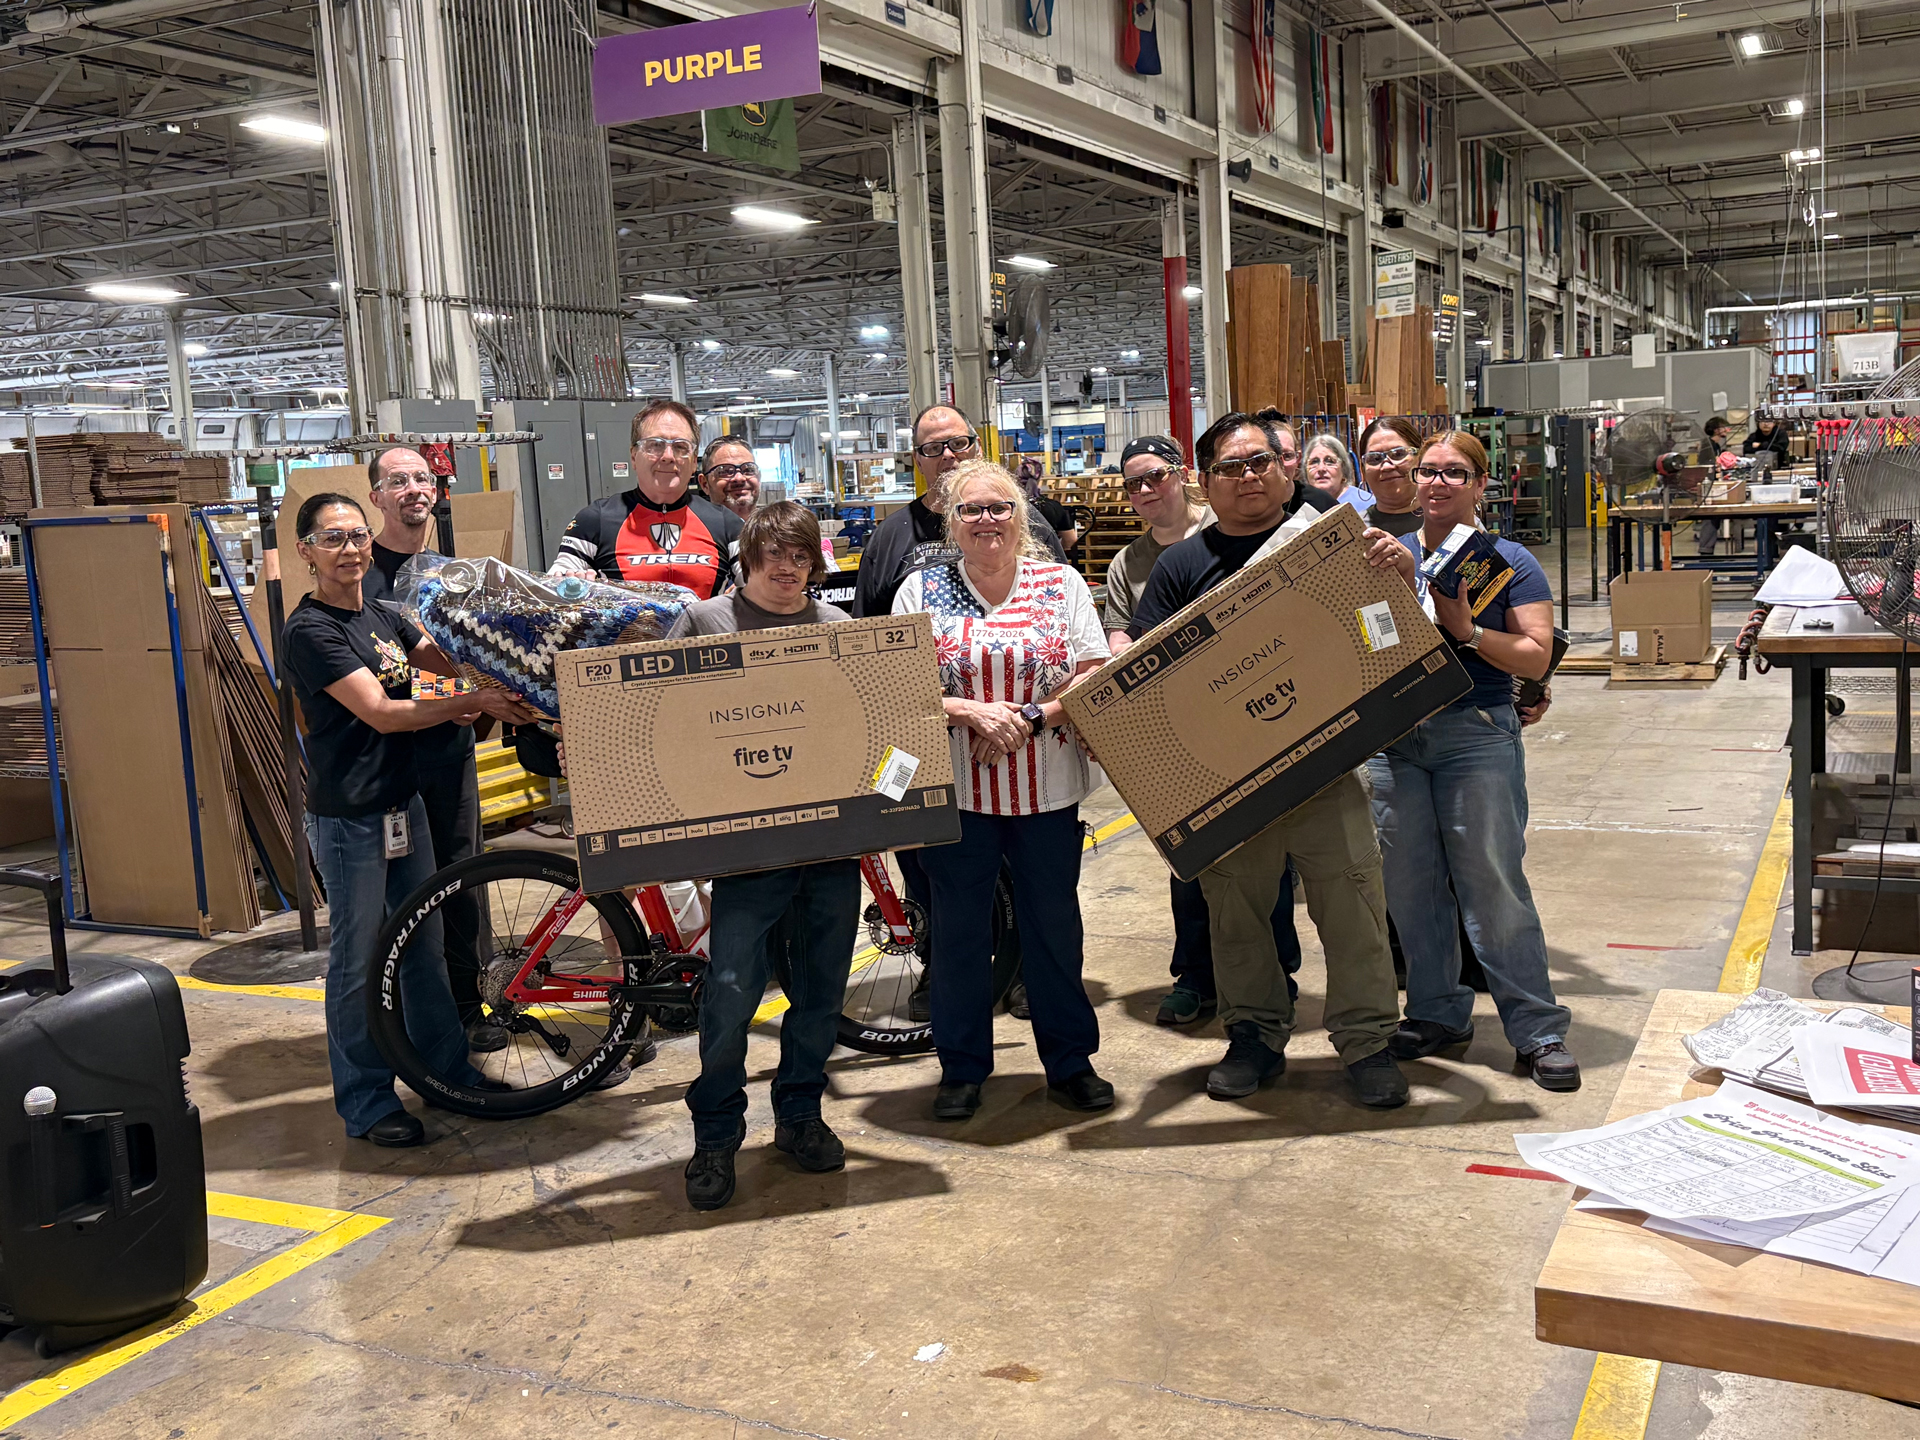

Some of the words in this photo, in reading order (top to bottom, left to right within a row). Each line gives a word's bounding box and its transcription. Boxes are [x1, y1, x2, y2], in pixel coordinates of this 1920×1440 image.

[644, 44, 762, 87] PURPLE
[727, 126, 753, 142] JOHN
[753, 132, 777, 149] DEERE
[1378, 254, 1397, 266] SAFETY
[1397, 251, 1413, 263] FIRST
[1853, 360, 1879, 372] 713B
[627, 553, 713, 565] TREK
[820, 586, 856, 603] ATRICK
[970, 629, 1025, 639] 1776-2026
[1173, 625, 1200, 648] HD
[699, 648, 729, 666] HD
[1656, 635, 1664, 663] KALAS
[585, 664, 612, 678] F20
[629, 655, 675, 677] LED
[1121, 653, 1161, 687] LED
[1208, 635, 1286, 693] INSIGNIA
[631, 680, 647, 688] Crystal
[658, 677, 674, 685] images
[1133, 686, 1145, 696] Crystal
[1153, 672, 1167, 683] images
[1178, 657, 1186, 666] best
[1090, 685, 1113, 706] F20
[1097, 695, 1115, 708] SERIES
[1245, 692, 1278, 718] fire
[1275, 678, 1296, 697] tv
[709, 700, 804, 724] INSIGNIA
[733, 747, 769, 767] fire
[772, 745, 793, 761] tv
[871, 855, 892, 893] REK
[549, 912, 573, 940] RSL
[382, 878, 462, 1011] BONTRAGER
[573, 990, 609, 999] SHIMA
[859, 1030, 933, 1043] BONTR
[1857, 1053, 1910, 1093] RESERVED
[1771, 1112, 1788, 1120] will
[1808, 1126, 1842, 1138] present
[1703, 1112, 1751, 1131] Prize
[1751, 1129, 1850, 1164] Preference
[1851, 1161, 1896, 1180] List
